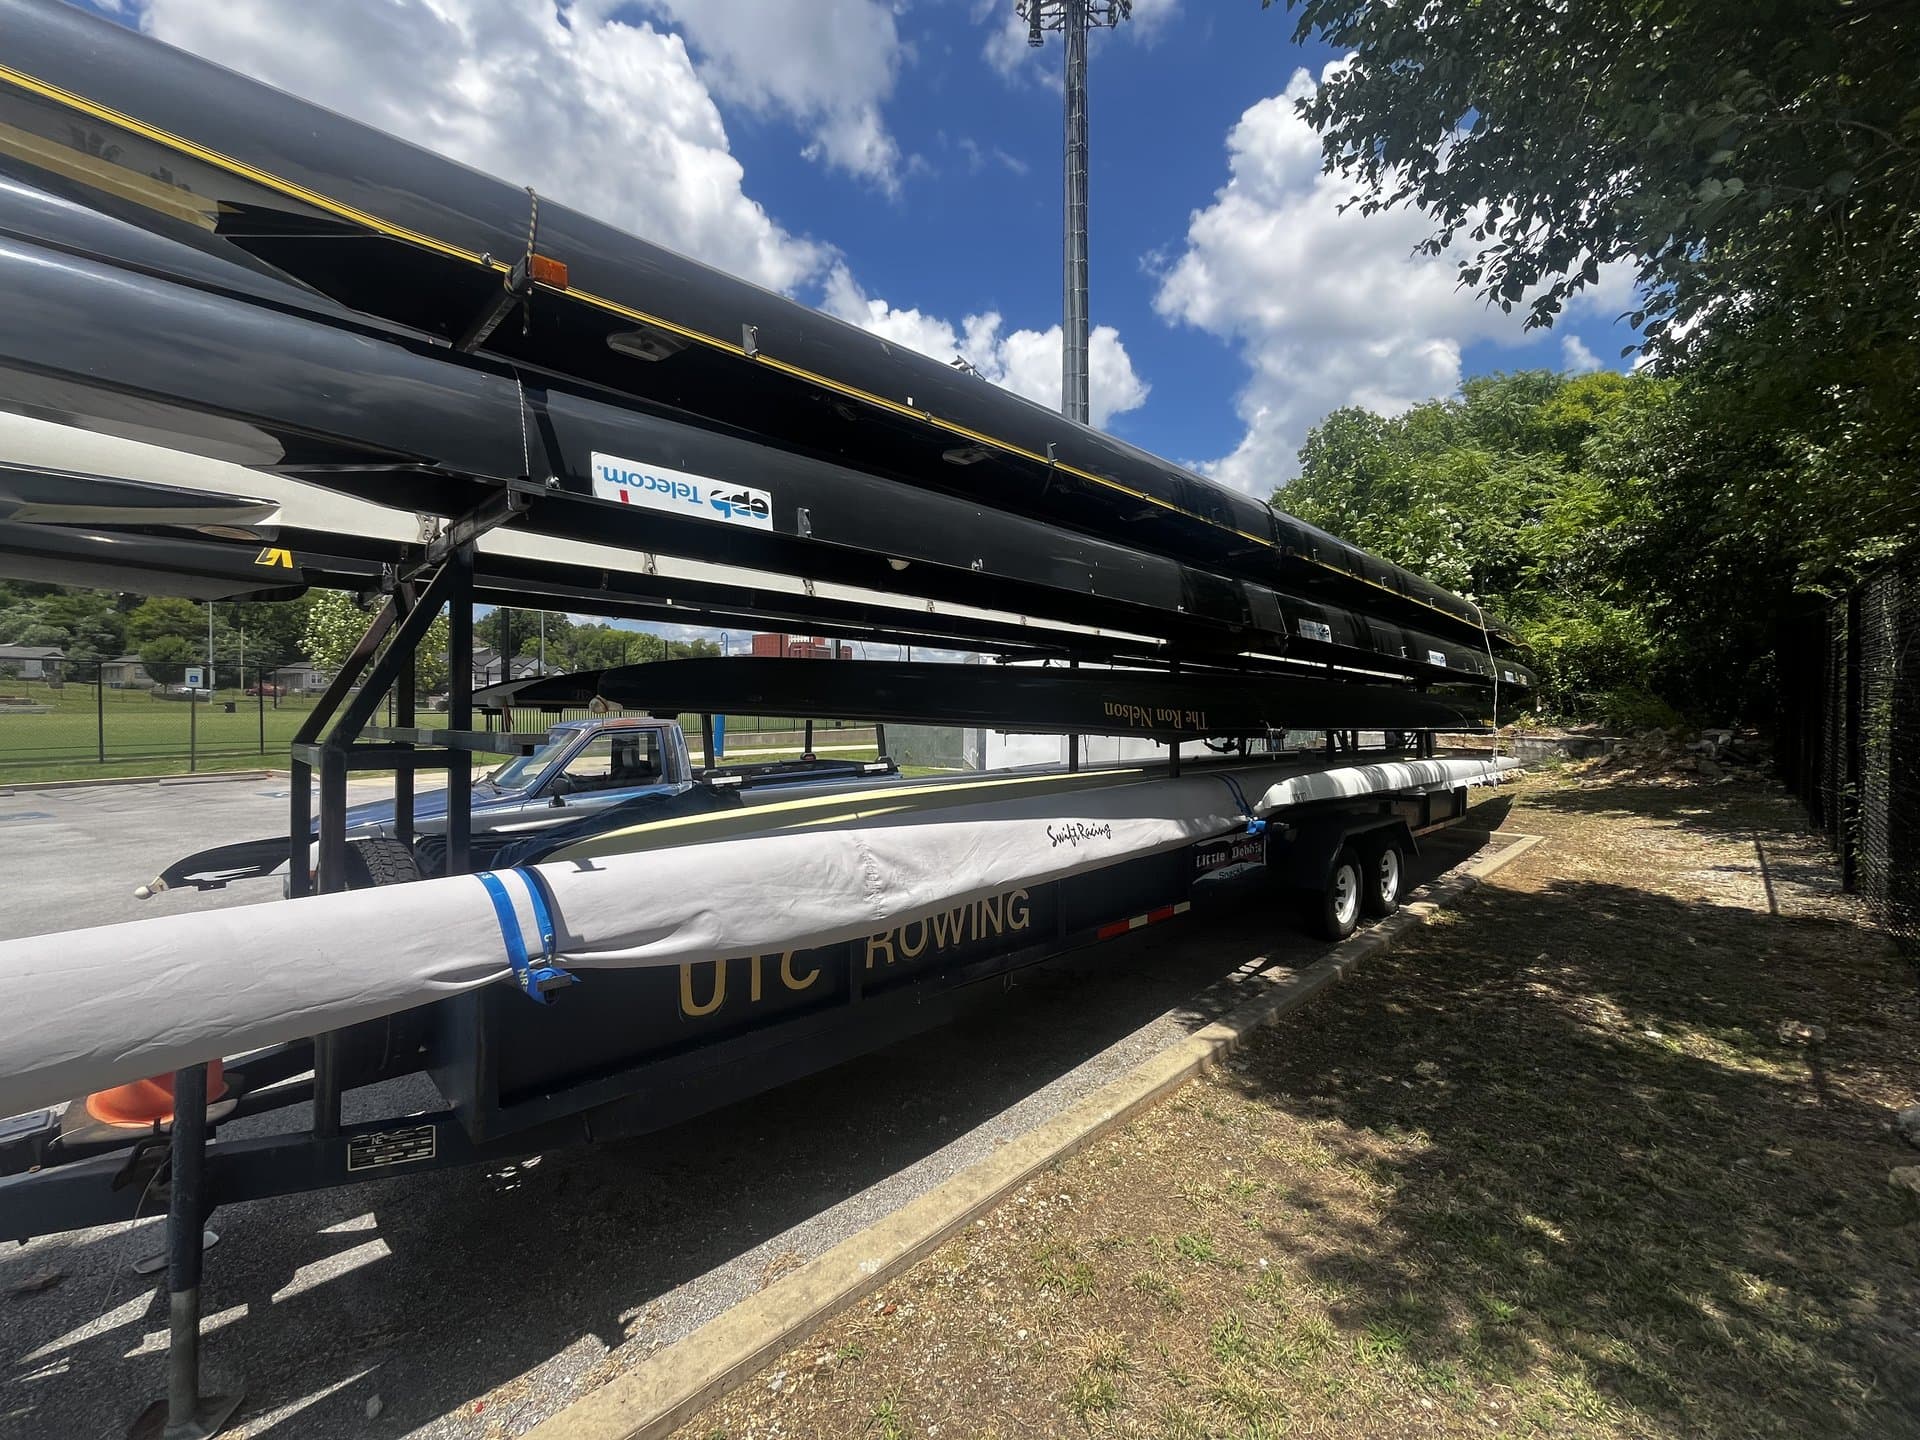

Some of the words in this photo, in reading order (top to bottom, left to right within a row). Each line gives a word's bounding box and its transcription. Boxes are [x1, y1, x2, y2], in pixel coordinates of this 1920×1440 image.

[603, 466, 703, 504] Telecom
[1104, 702, 1153, 728] Nelson
[1156, 708, 1183, 729] Ron
[1185, 711, 1209, 731] The
[1196, 851, 1226, 868] Little
[865, 889, 1030, 969] ROWING
